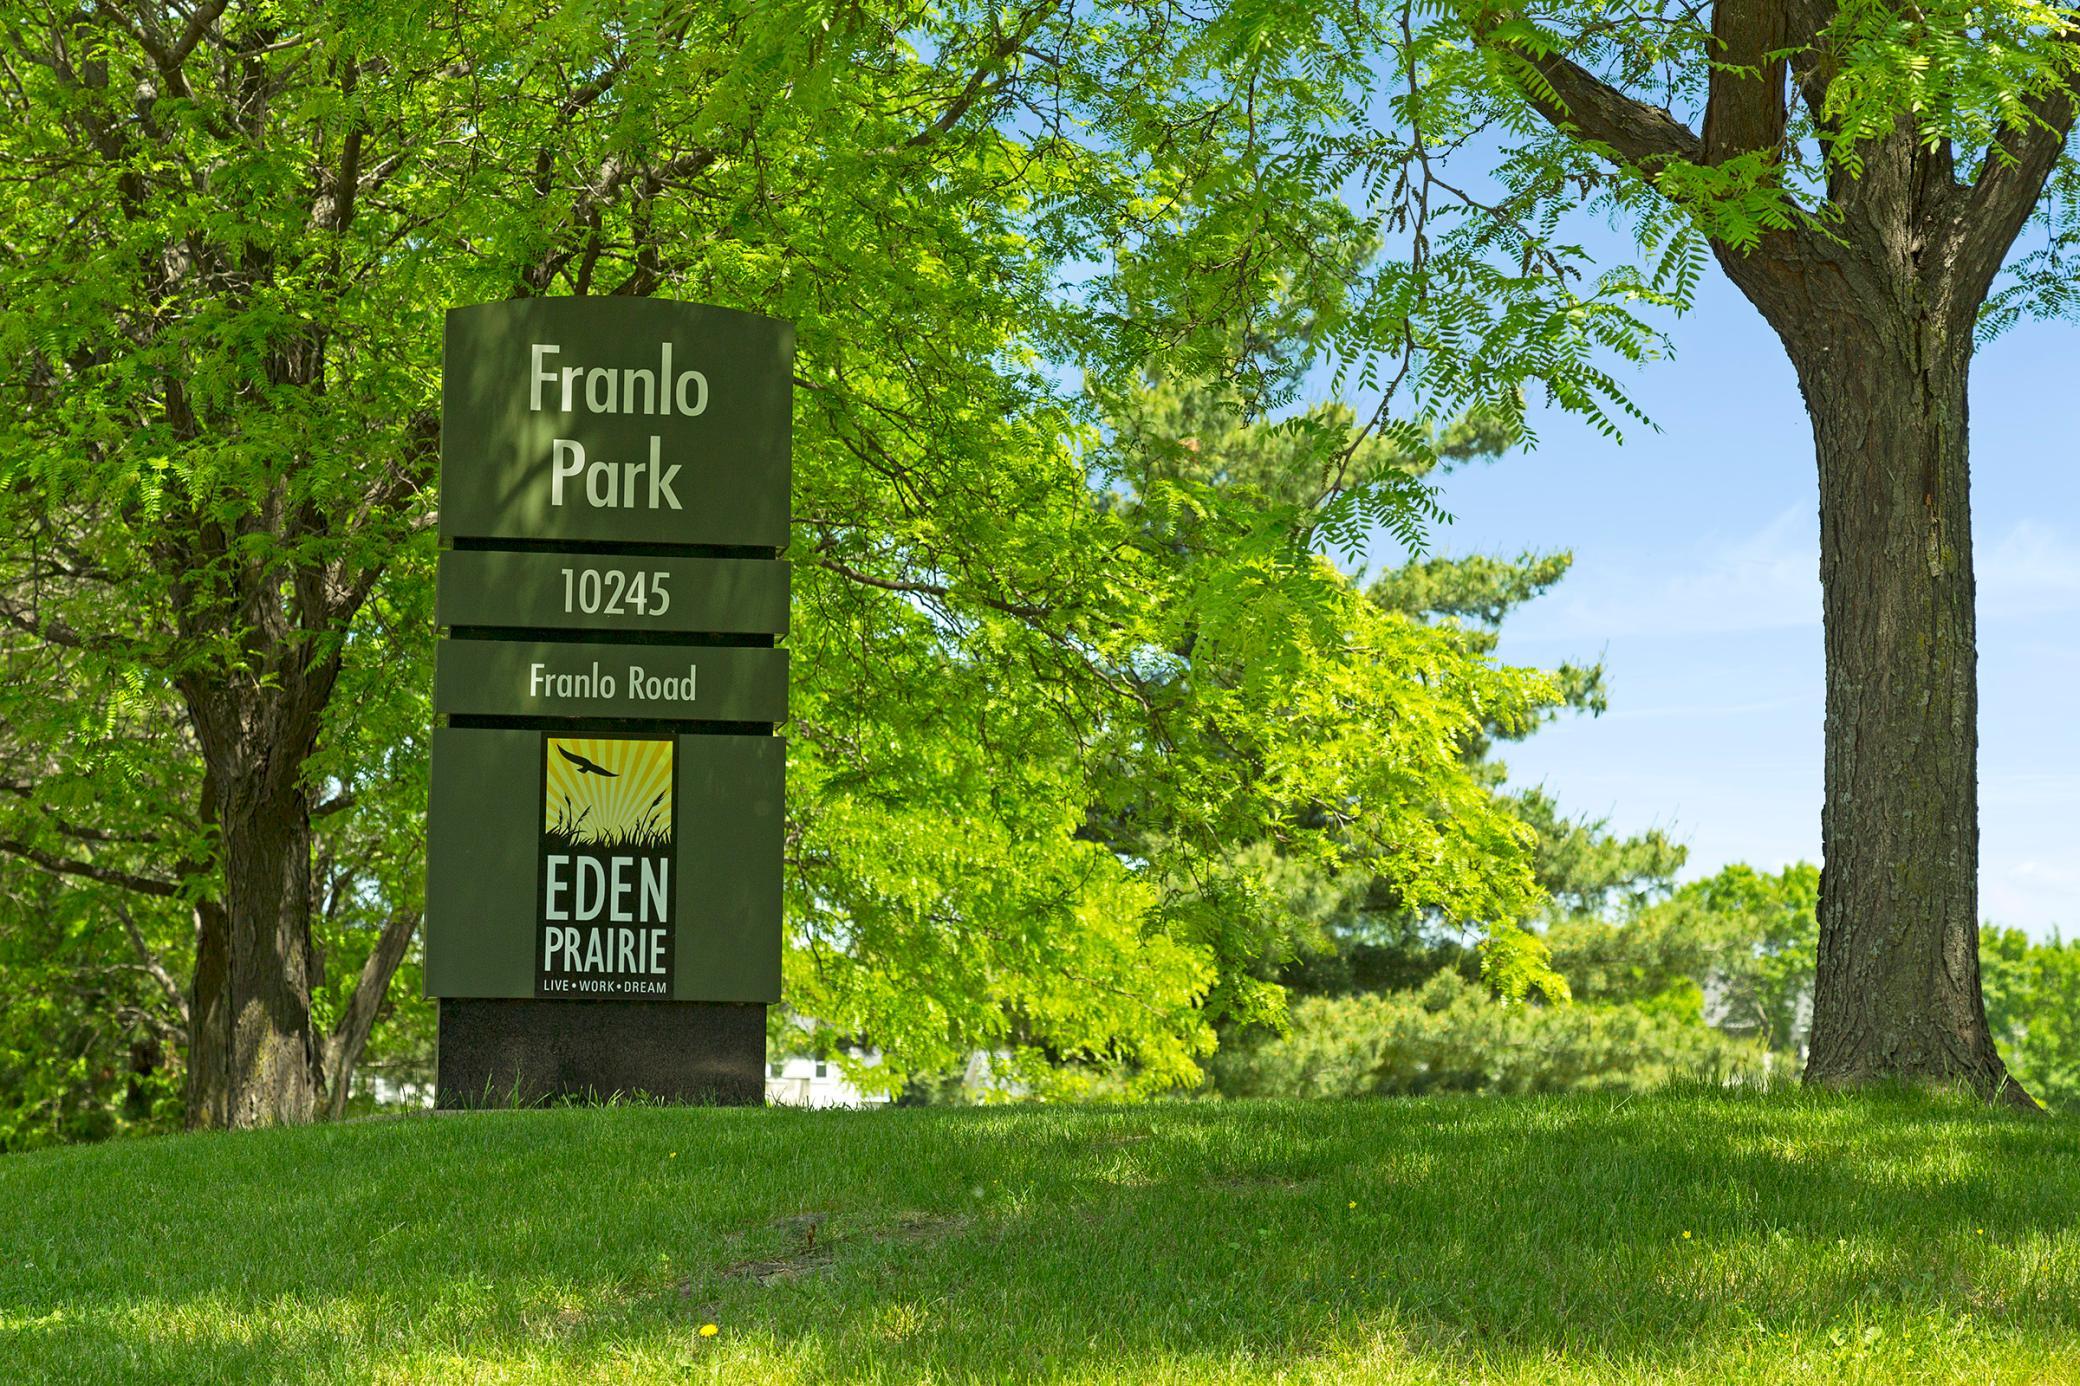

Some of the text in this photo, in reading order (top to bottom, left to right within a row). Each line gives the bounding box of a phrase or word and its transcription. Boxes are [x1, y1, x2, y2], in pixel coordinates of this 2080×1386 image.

[530, 342, 709, 416] Franlo
[551, 435, 683, 510] Park
[561, 568, 671, 616] 10245
[530, 661, 697, 701] Franlo Road
[545, 854, 669, 923] EDEN
[544, 926, 667, 974] PRAIRIE
